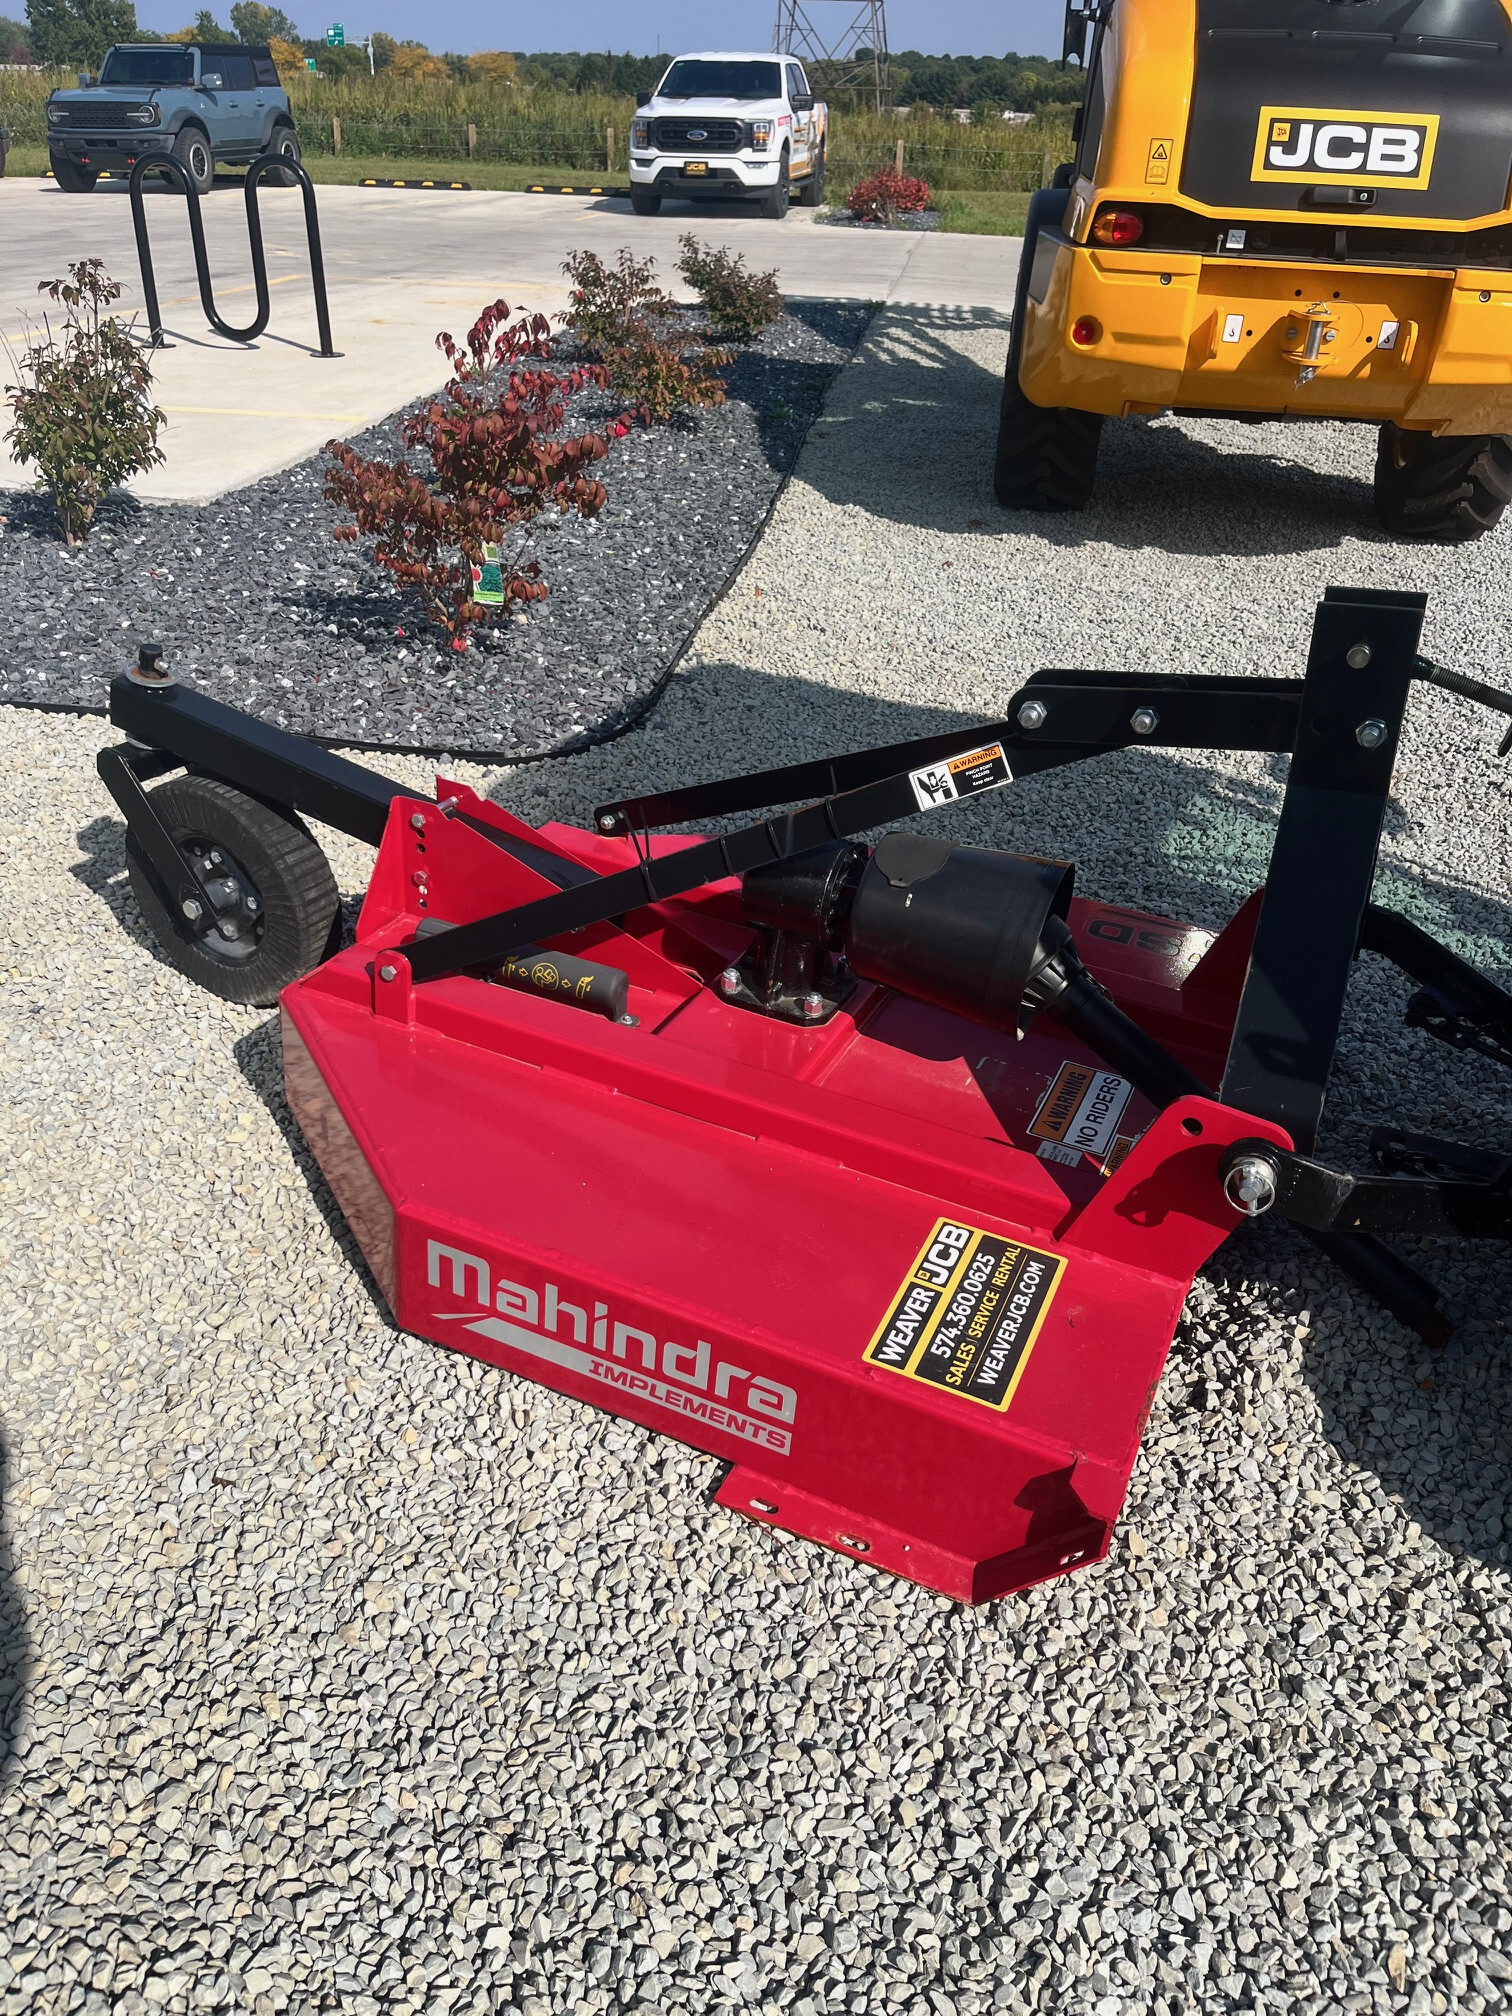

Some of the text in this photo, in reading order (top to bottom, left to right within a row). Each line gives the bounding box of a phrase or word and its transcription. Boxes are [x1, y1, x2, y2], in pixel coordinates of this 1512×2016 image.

[686, 163, 706, 171] JCB
[1269, 123, 1420, 173] JCB
[959, 749, 997, 768] WARNING
[1048, 1071, 1087, 1122] WARNING
[1074, 1076, 1122, 1148] NO RIDERS
[877, 1224, 970, 1362] WEAVER JCB
[930, 1252, 996, 1359] 574.360.0625
[945, 1246, 1021, 1386] SALES SERVICE RENTAL
[977, 1261, 1046, 1386] WEAVERJCB.COM
[588, 1358, 788, 1450] IMPLEMENTS
